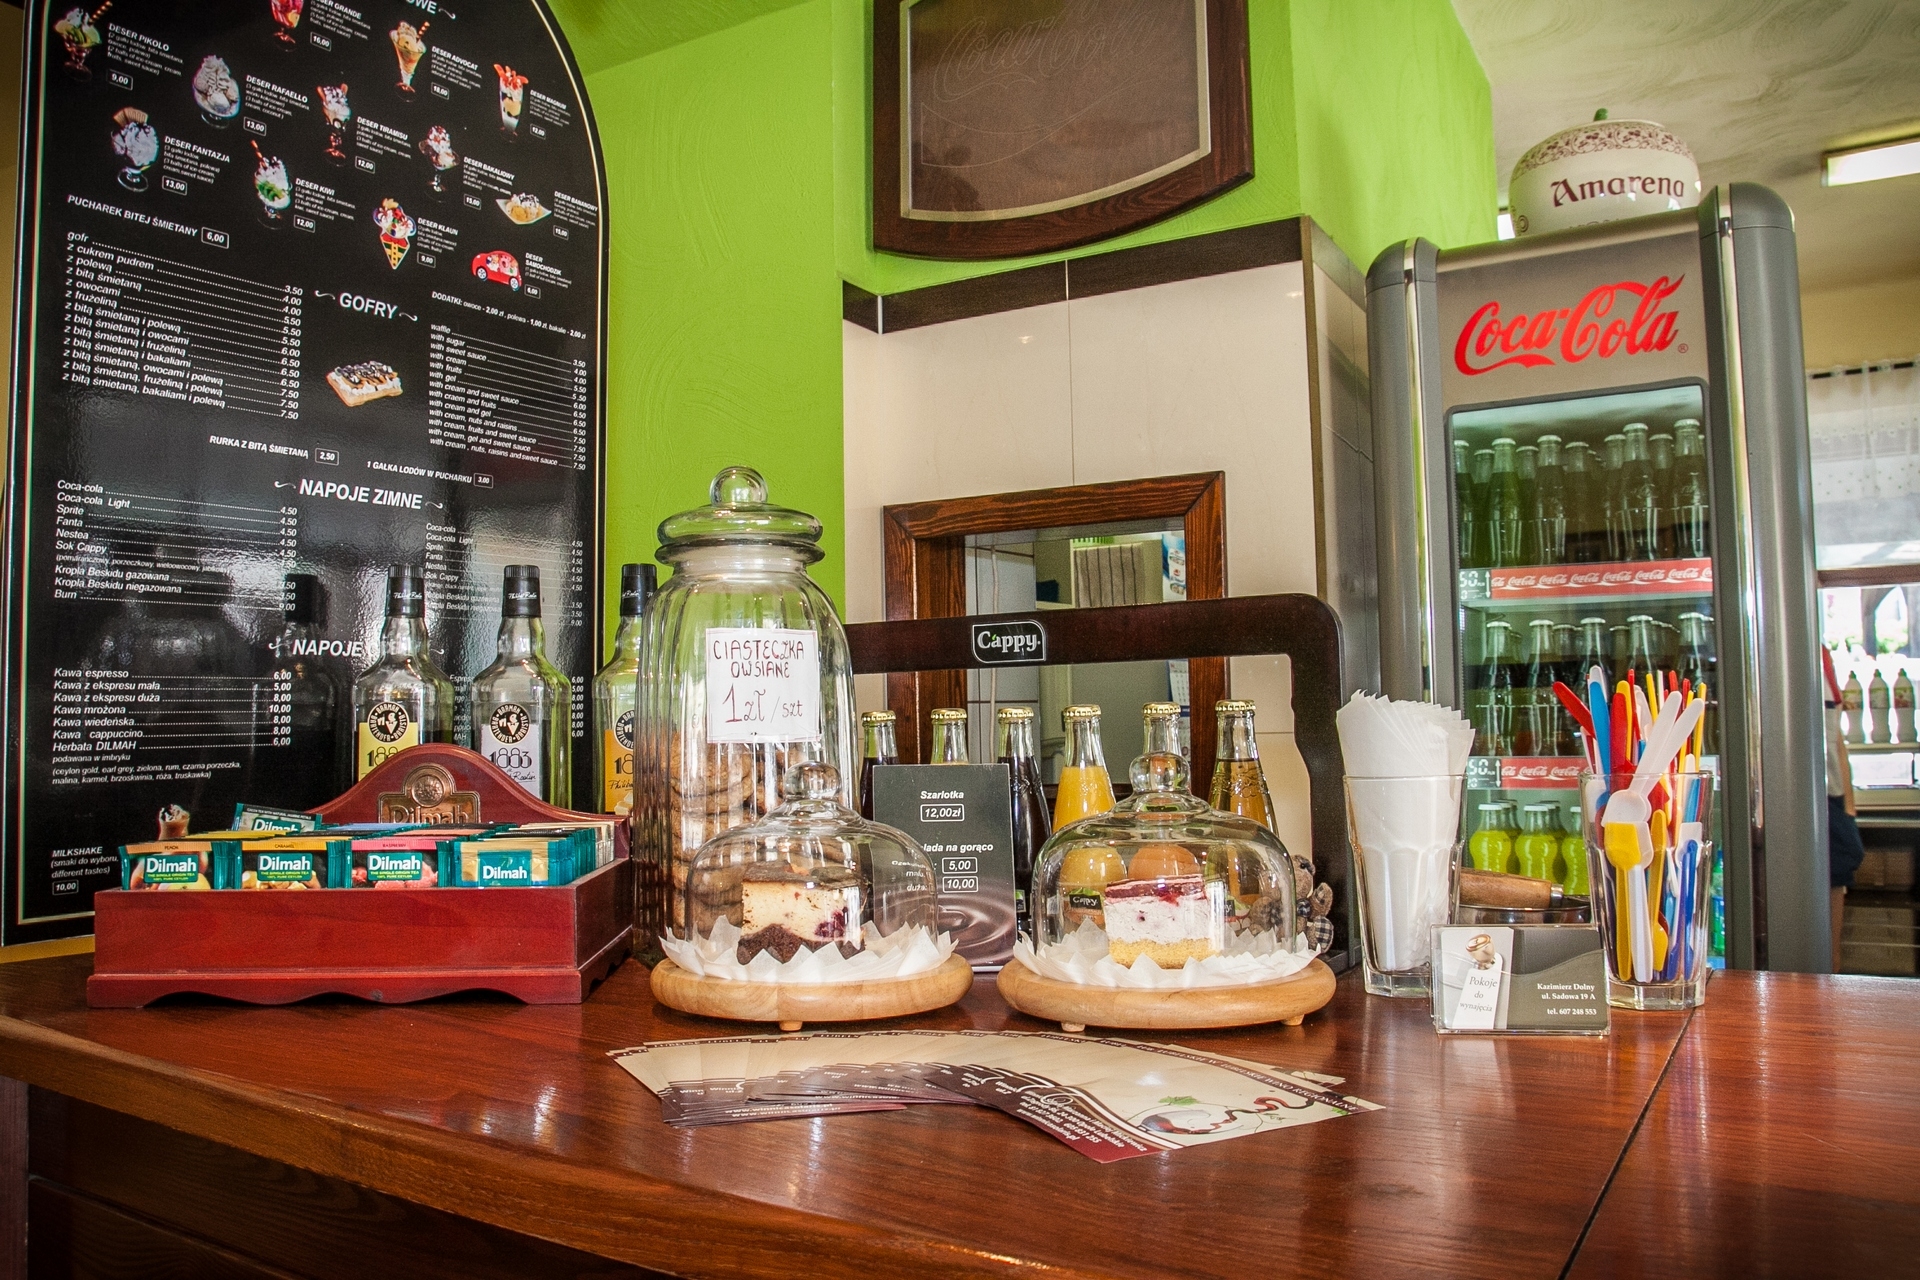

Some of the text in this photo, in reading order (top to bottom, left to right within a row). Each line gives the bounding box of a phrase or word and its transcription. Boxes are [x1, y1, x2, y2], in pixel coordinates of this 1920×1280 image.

[109, 23, 169, 52] DESER PIKOLO
[432, 46, 478, 70] DESER ADVOCAT
[111, 74, 129, 85] 9,00
[246, 75, 308, 103] DESER RAFAELLO
[246, 121, 265, 132] 13,00
[357, 116, 378, 130] DESER
[165, 135, 230, 163] DESER FANTAZJA
[357, 159, 374, 170] 12,00
[463, 157, 482, 170] DESER
[165, 179, 185, 191] 13,00
[295, 178, 335, 196] DESER KIWI
[1551, 175, 1684, 207] Amarena
[67, 194, 197, 237] PUCHAREK BITEJ ŚMIETANY
[297, 218, 314, 229] 12,00
[417, 217, 437, 230] DESER
[67, 231, 89, 243] gofr
[207, 232, 224, 244] 6,00
[67, 243, 73, 251] z
[77, 245, 114, 261] cukrem
[117, 255, 154, 270] pudrem
[421, 255, 433, 264] 9,00
[525, 253, 543, 262] DESER
[76, 257, 112, 273] polewą
[76, 267, 95, 280] bitą
[98, 273, 142, 291] śmietaną
[76, 281, 121, 297] owocami
[66, 290, 118, 309] z frużeliną
[431, 291, 462, 305] DODATKI:
[340, 293, 398, 320] GOFRY
[62, 373, 68, 381] z
[71, 373, 90, 386] bitą
[142, 385, 187, 401] bakaliami
[193, 395, 226, 408] polewą
[209, 435, 309, 459] RURKA Z BITĄ ŚMIETANĄ
[320, 452, 334, 462] 2,50
[372, 462, 398, 474] GAŁKA
[399, 464, 426, 476] LODÓW
[427, 469, 434, 477] W
[435, 470, 472, 483] PUCHARKU
[57, 480, 103, 493] Coca-cola
[478, 476, 490, 484] 3,00
[57, 492, 130, 509] Coca-cola Light
[300, 479, 422, 510] NAPOJE ZIMNE
[56, 504, 84, 516] Sprite
[56, 516, 83, 527] Fanta
[56, 529, 88, 540] Nestea
[56, 541, 107, 555] Sok Cappy
[292, 639, 361, 655] NAPOJE
[977, 631, 1037, 652] Cappy
[713, 640, 805, 660] CIASTECZKA
[54, 668, 291, 681] Kawa espresso 6,00
[730, 661, 790, 678] OWSIANE
[54, 680, 82, 690] Kawa
[93, 682, 135, 692] ekspresu
[138, 681, 160, 690] mała
[273, 683, 291, 691] 5,00
[53, 692, 81, 702] Kawa
[92, 694, 135, 704] ekspresu
[138, 693, 160, 702] duża
[273, 693, 291, 702] 8,00
[53, 704, 291, 715] Kawa mrożona 10,00
[53, 715, 291, 727] Kawa wiedeńska 8,00
[53, 726, 290, 740] Kawa cappuccino 8,00
[52, 737, 290, 752] Herbata DILMAH 6,00
[920, 790, 964, 800] Szarlotka
[925, 807, 961, 819] 12,00zł
[52, 846, 103, 857] MILKSHAKE
[945, 842, 993, 855] na gorąco
[146, 858, 196, 873] Dilmah
[259, 856, 310, 871] Dilmah
[369, 856, 420, 870] Dilmah
[949, 860, 971, 871] 5,00
[483, 866, 527, 880] Dilmah
[56, 882, 76, 891] 10,00
[946, 878, 974, 890] 10,00
[1469, 976, 1498, 988] Pokoje
[1537, 983, 1595, 993] Kazimierz Dolny
[1474, 991, 1483, 999] do
[1459, 1001, 1493, 1013] wynajęcia
